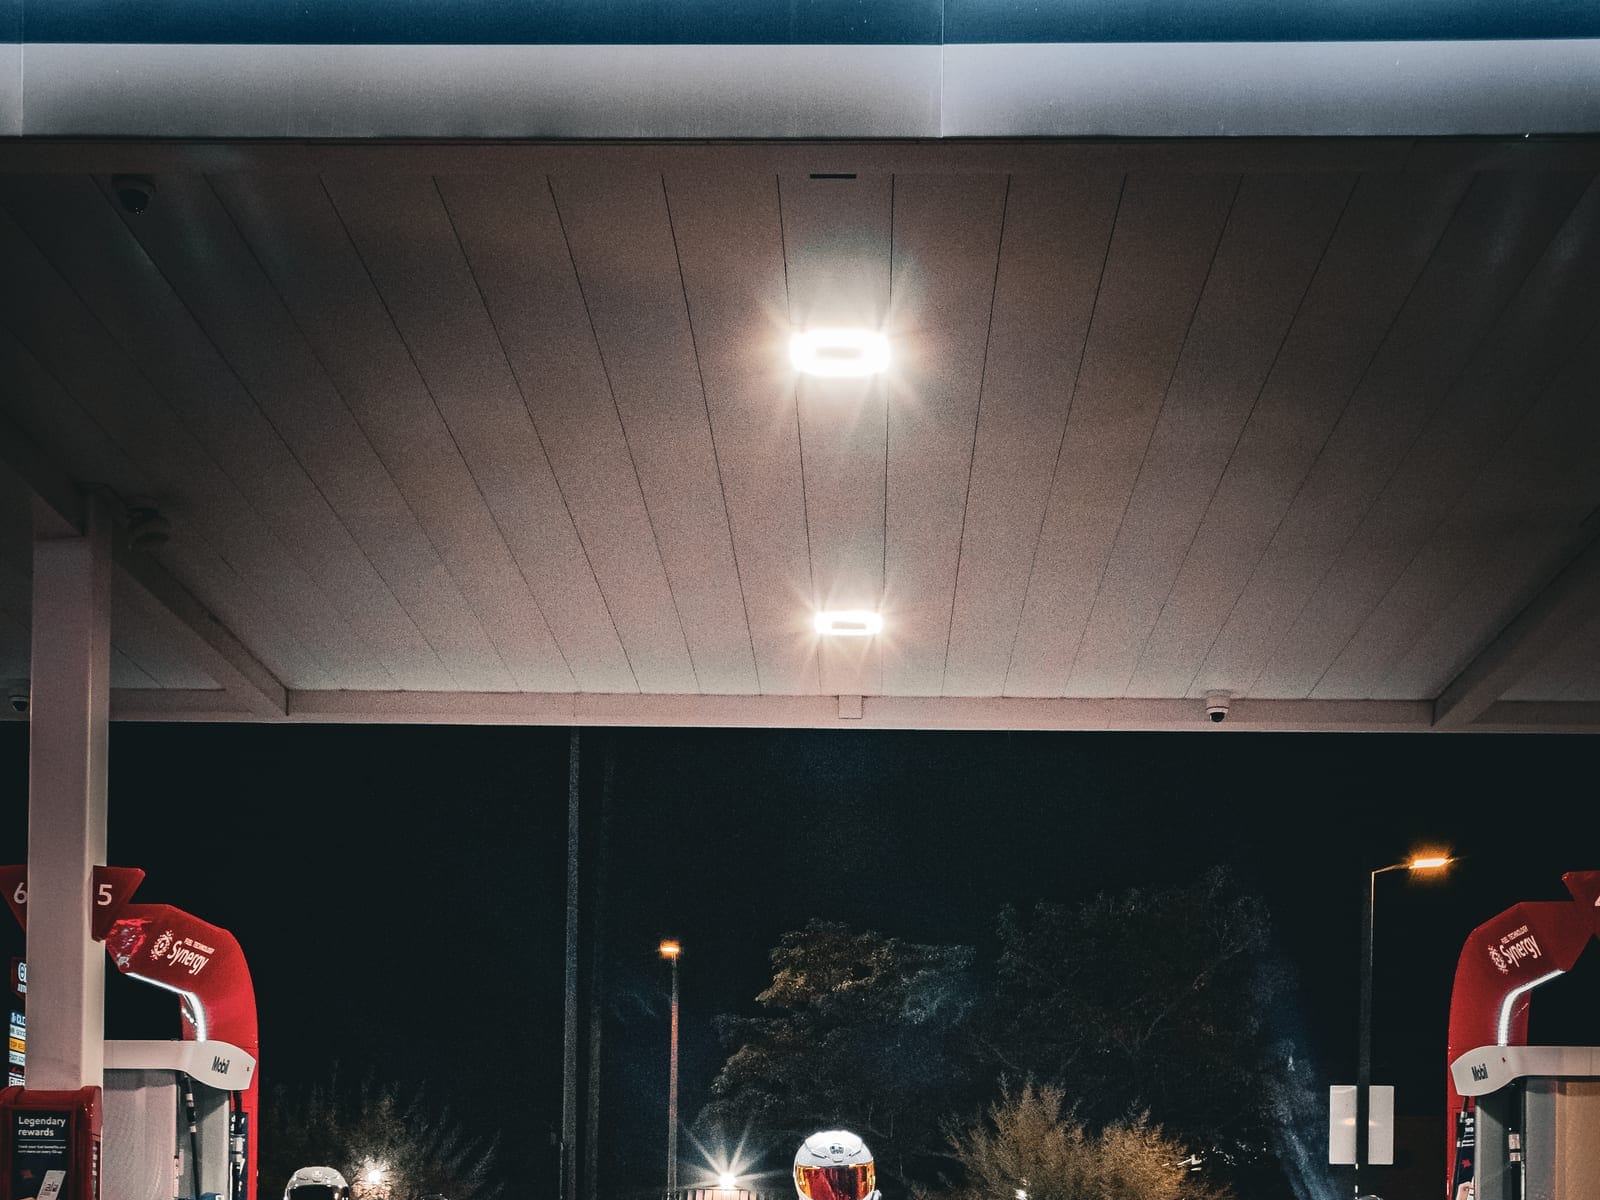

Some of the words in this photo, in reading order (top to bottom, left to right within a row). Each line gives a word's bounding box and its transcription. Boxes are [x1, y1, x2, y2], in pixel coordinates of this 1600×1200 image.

[13, 882, 28, 904] 6
[97, 884, 113, 906] 5
[166, 940, 210, 976] Synergy
[1499, 935, 1542, 968] Synergy
[211, 1055, 231, 1075] Mobil
[1471, 1063, 1488, 1082] Mobil
[18, 1116, 66, 1128] Legendary
[18, 1128, 54, 1137] rewards
